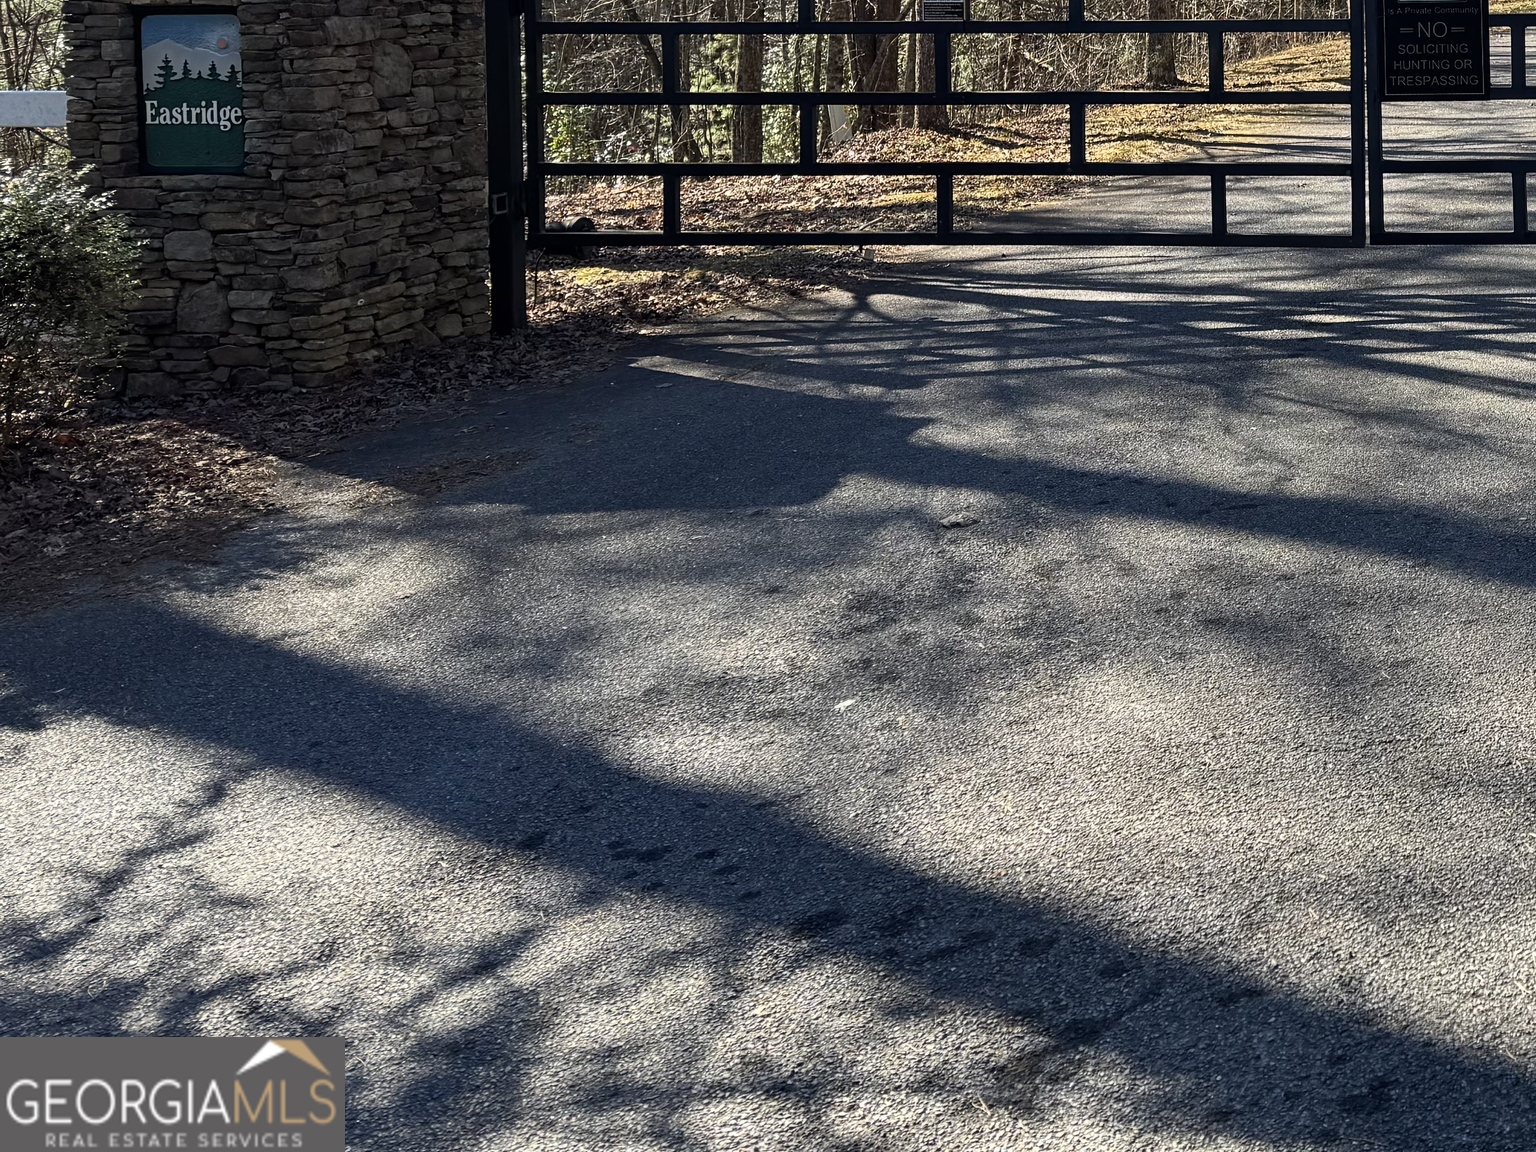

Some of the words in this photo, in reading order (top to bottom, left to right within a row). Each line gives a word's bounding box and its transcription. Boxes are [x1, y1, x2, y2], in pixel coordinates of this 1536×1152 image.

[1404, 7, 1432, 15] Private
[1434, 6, 1479, 15] Community
[1418, 21, 1448, 38] NO
[1398, 43, 1469, 54] SOLICITING
[1393, 59, 1450, 70] HUNTING
[1454, 59, 1473, 69] OR
[1389, 75, 1479, 86] TRESPASSING
[145, 100, 242, 131] Eastridge
